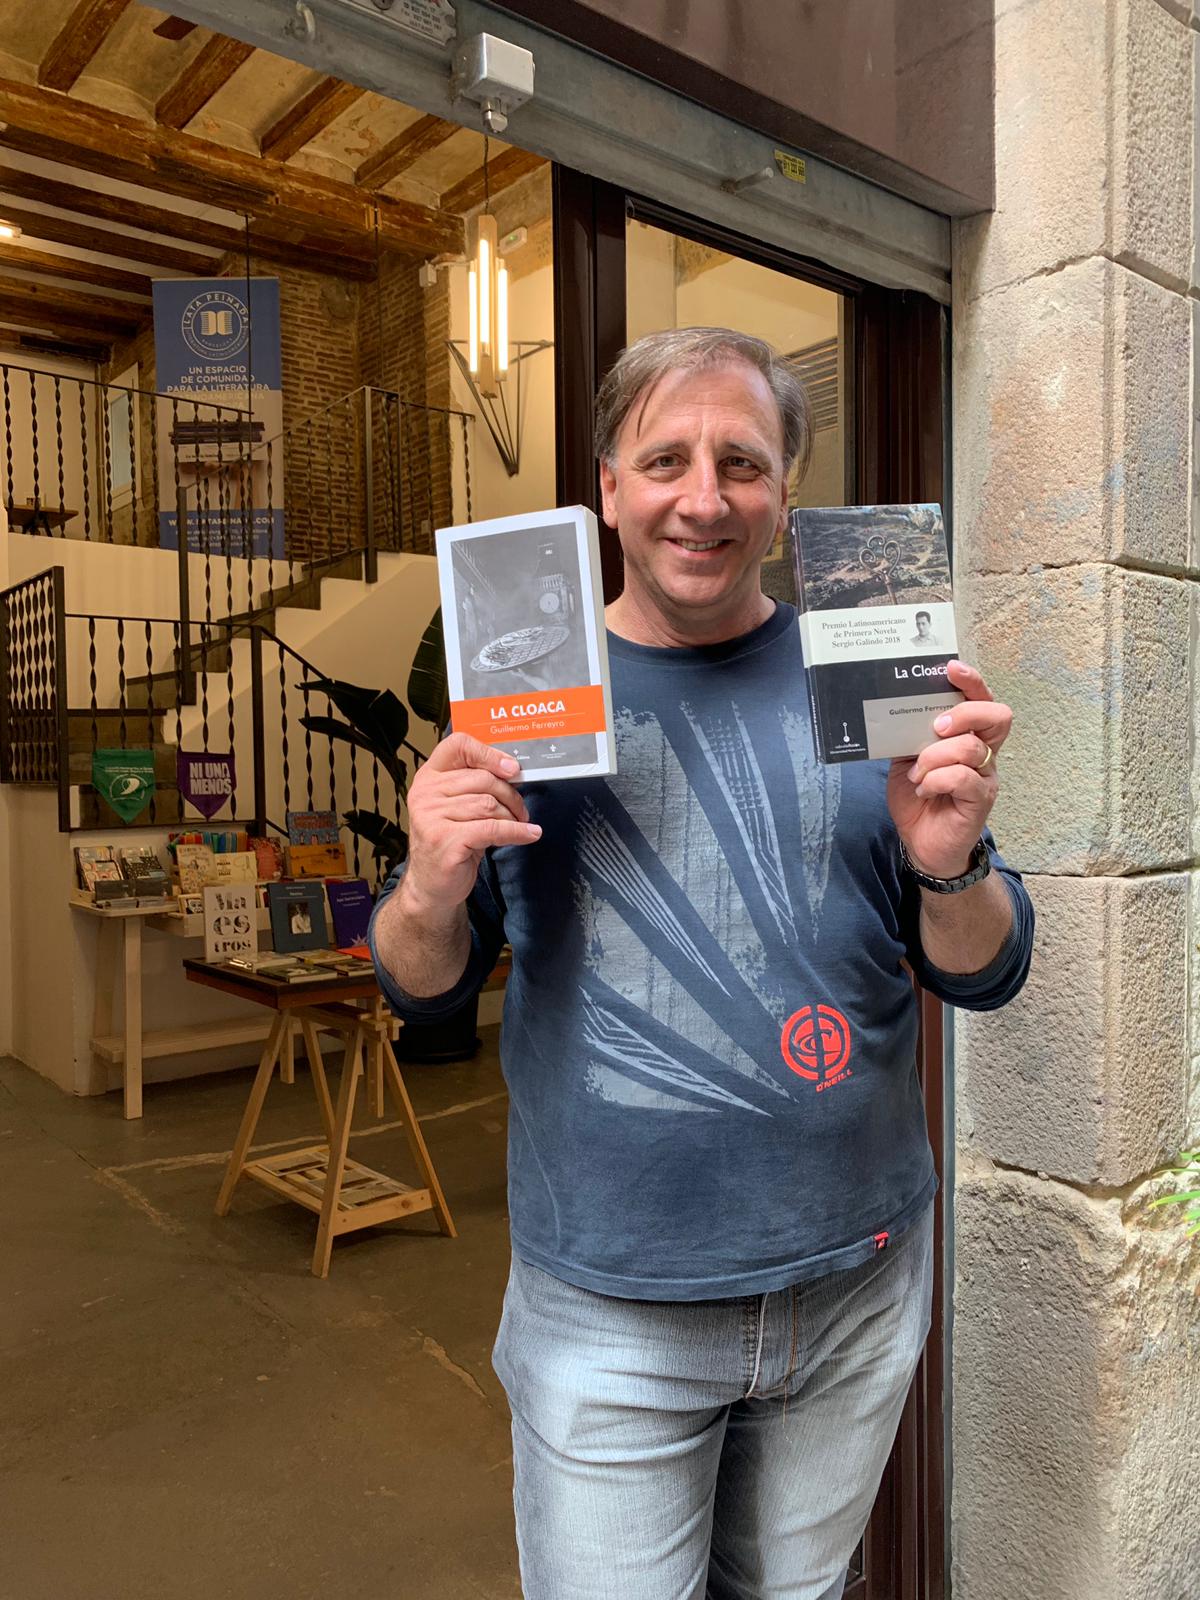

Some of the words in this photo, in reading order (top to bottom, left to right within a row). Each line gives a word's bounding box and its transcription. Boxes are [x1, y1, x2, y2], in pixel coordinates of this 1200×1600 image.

[183, 300, 202, 325] LATA
[206, 293, 249, 323] PEINADA
[188, 367, 203, 375] UN
[205, 365, 247, 374] ESPACIO
[180, 375, 194, 384] DE
[166, 384, 193, 393] PARA
[195, 384, 208, 393] LA
[210, 383, 271, 392] LITERATURA
[821, 621, 848, 630] Premio
[848, 618, 906, 628] Latinoamericano
[833, 631, 842, 639] de
[843, 629, 873, 638] Primera
[873, 627, 897, 635] Novela
[832, 640, 855, 649] Sergio
[855, 638, 884, 647] Galindo
[884, 636, 901, 644] 2018
[894, 666, 909, 679] La
[911, 664, 948, 677] Cloaca
[490, 706, 508, 720] LA
[511, 699, 566, 717] CLOACA
[889, 707, 924, 716] Guillermo
[489, 723, 530, 735] Guillermo
[531, 720, 565, 729] Ferreyro
[189, 762, 203, 778] NI
[205, 762, 231, 778] UNA
[189, 778, 232, 795] MENOS
